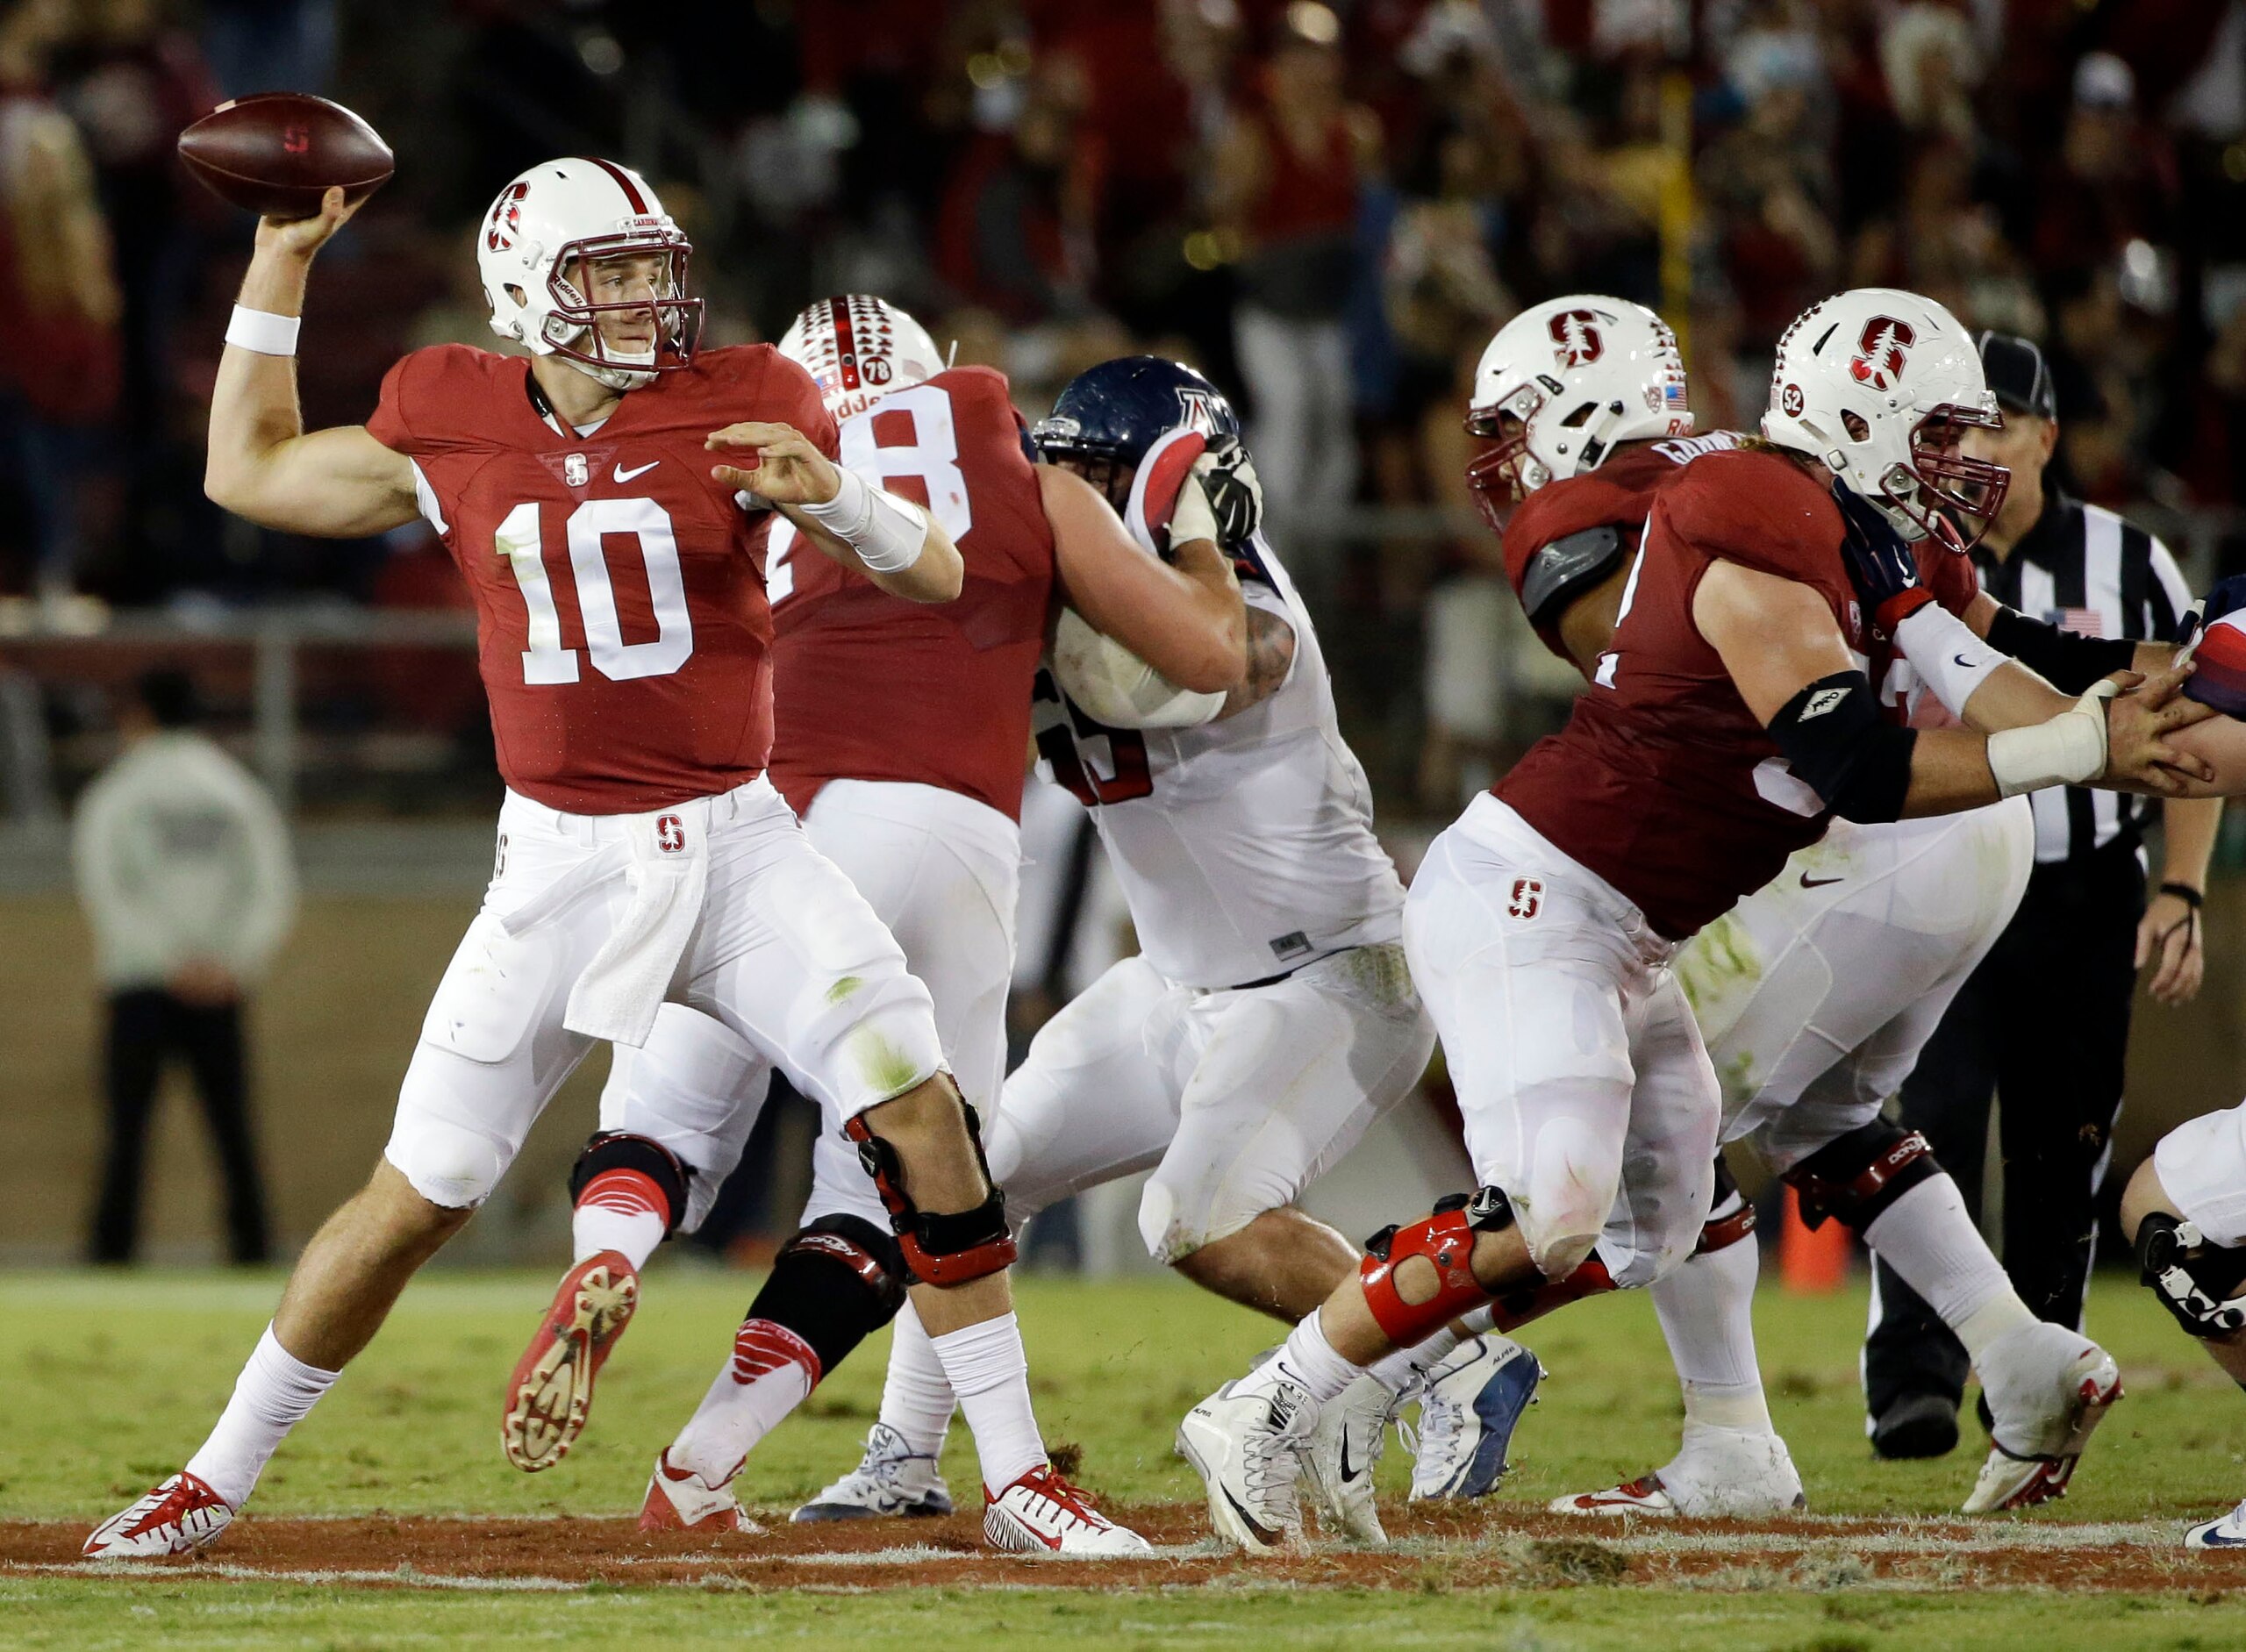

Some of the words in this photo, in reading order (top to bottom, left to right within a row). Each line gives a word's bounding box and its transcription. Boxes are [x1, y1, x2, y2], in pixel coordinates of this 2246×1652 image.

[1549, 310, 1604, 368] S
[1849, 314, 1916, 392] S
[865, 361, 891, 382] 78
[1784, 389, 1802, 412] 52
[494, 497, 694, 685] 10
[657, 815, 685, 852] S
[1508, 876, 1542, 919] S
